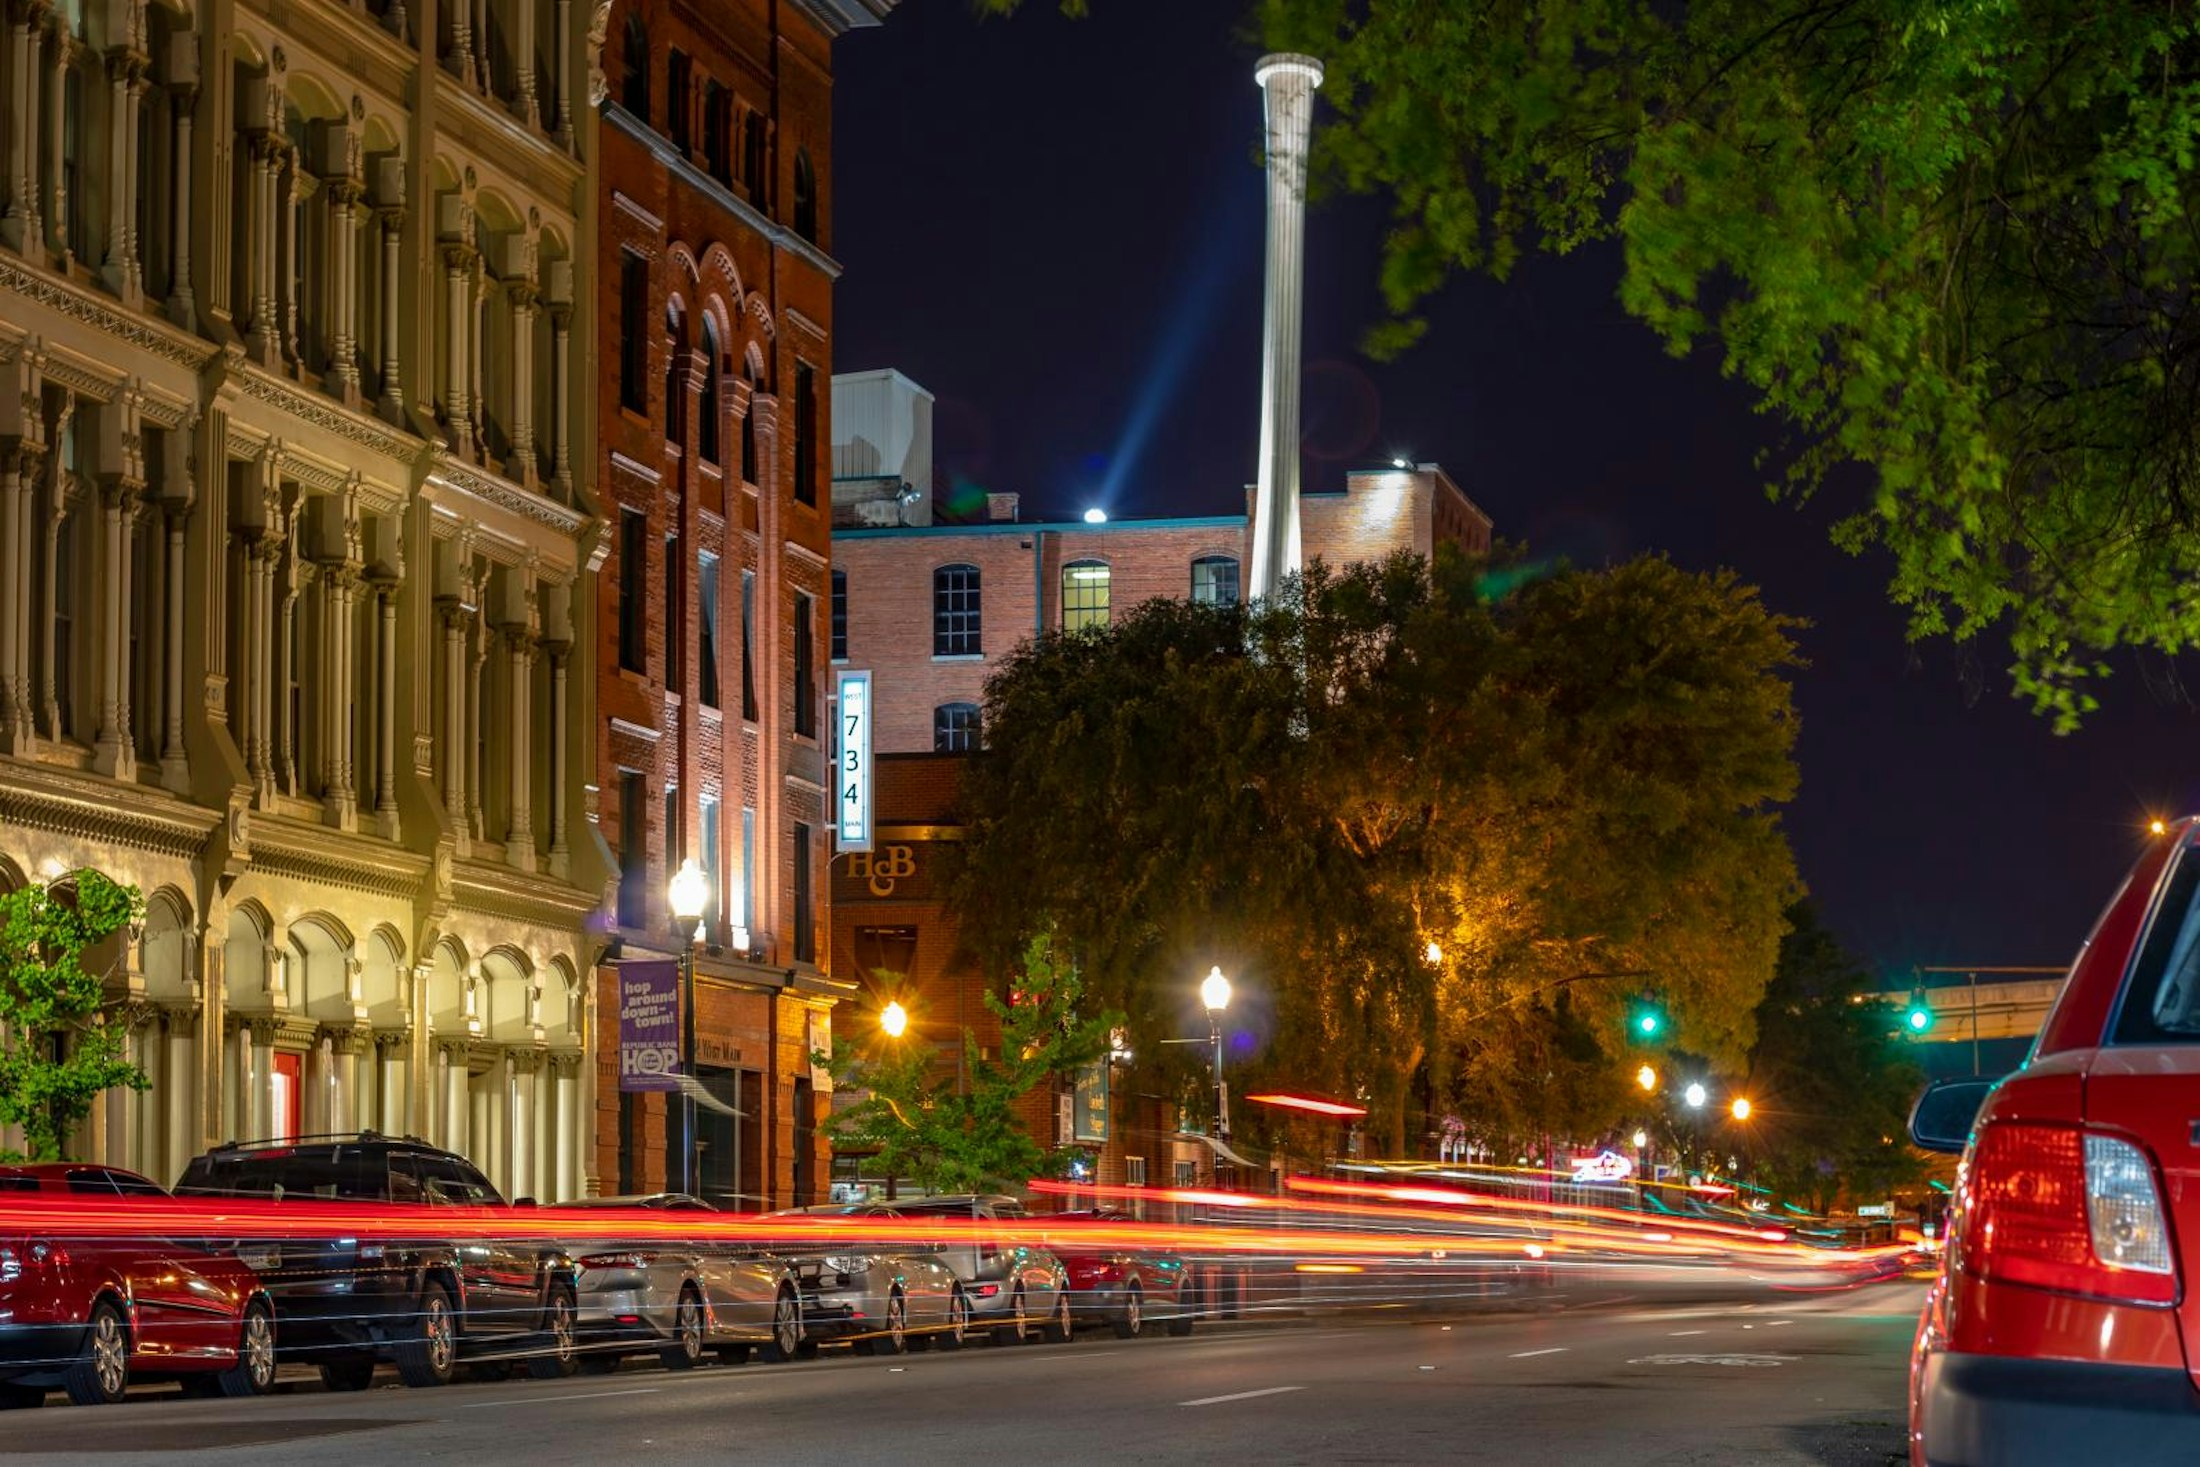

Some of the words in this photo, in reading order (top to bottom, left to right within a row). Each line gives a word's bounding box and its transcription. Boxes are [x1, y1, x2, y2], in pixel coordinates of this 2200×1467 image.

[844, 715, 859, 805] 734
[846, 845, 916, 897] H&B
[625, 983, 651, 995] hop
[629, 991, 676, 1006] around
[622, 1007, 666, 1019] down-
[635, 1013, 674, 1028] town!
[622, 1049, 678, 1074] HOP
